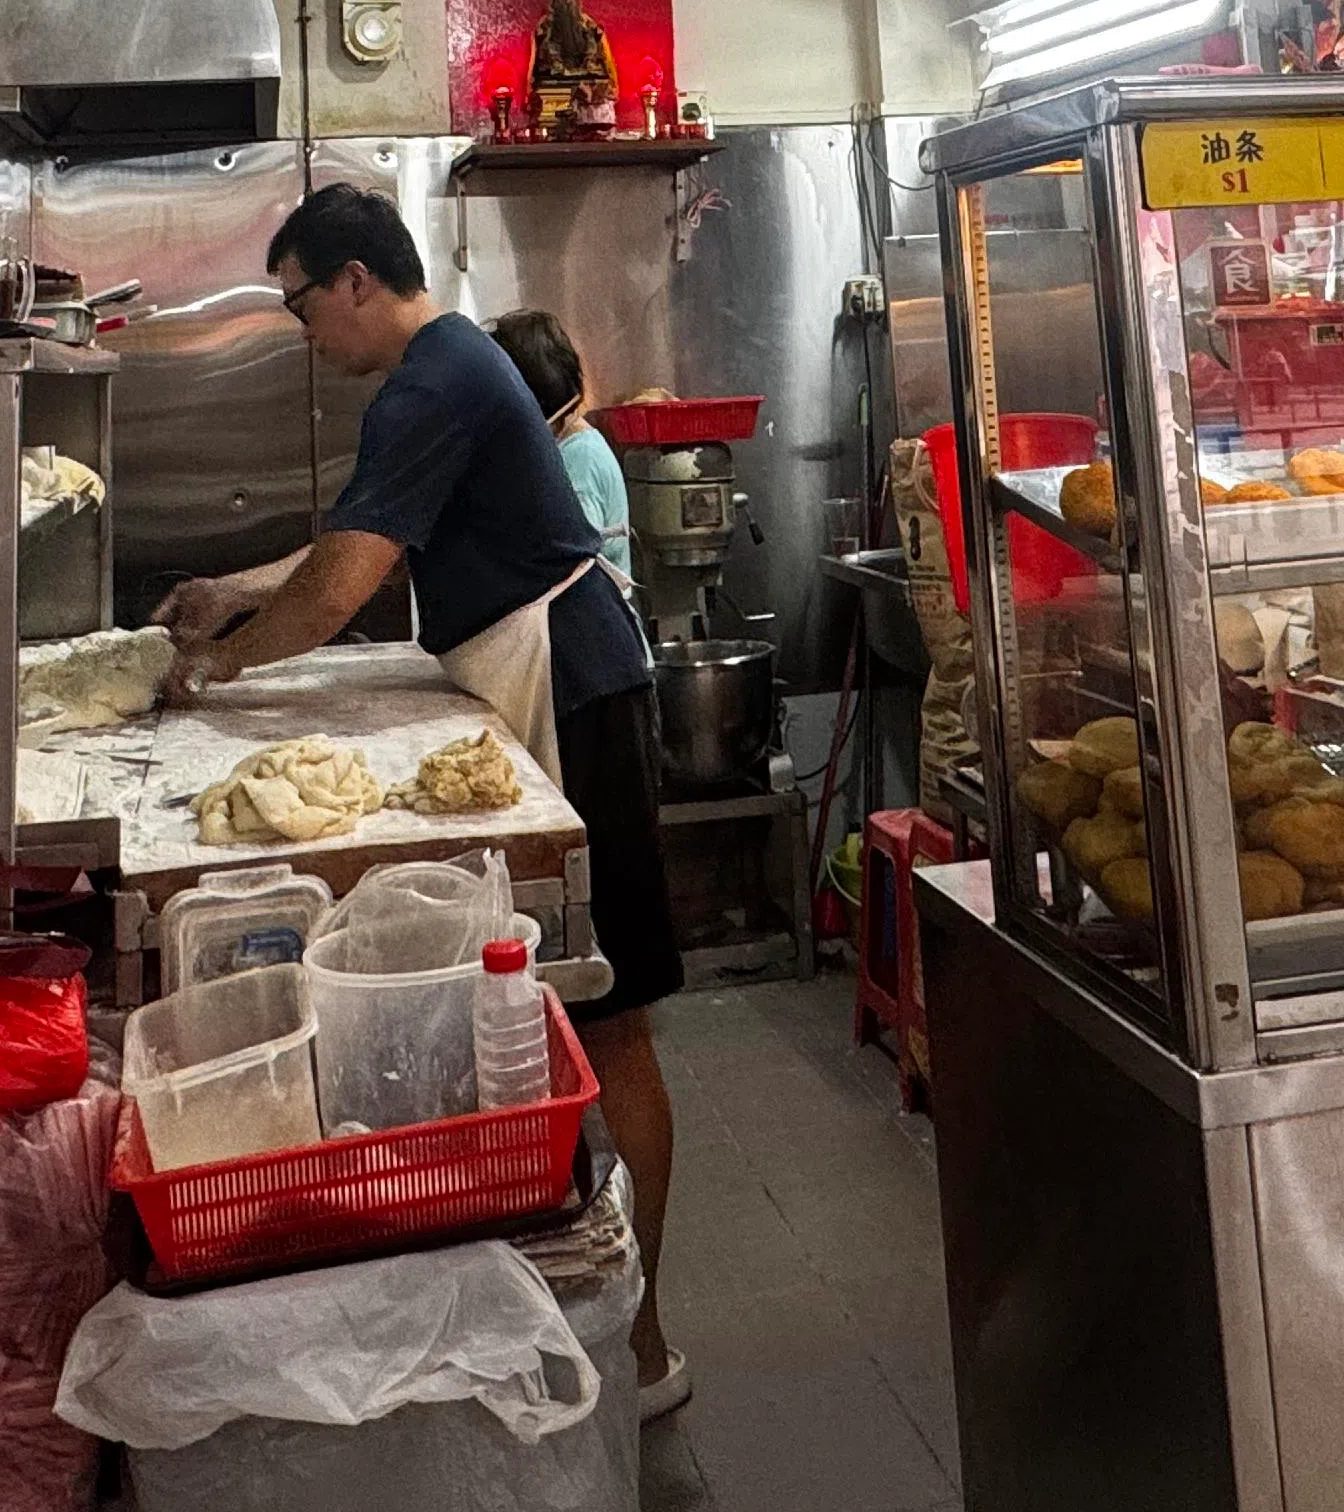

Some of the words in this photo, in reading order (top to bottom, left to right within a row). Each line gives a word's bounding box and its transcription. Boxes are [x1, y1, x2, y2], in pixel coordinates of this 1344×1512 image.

[1201, 130, 1264, 164] 油条
[1221, 168, 1249, 192] $1
[1219, 248, 1260, 294] 食
